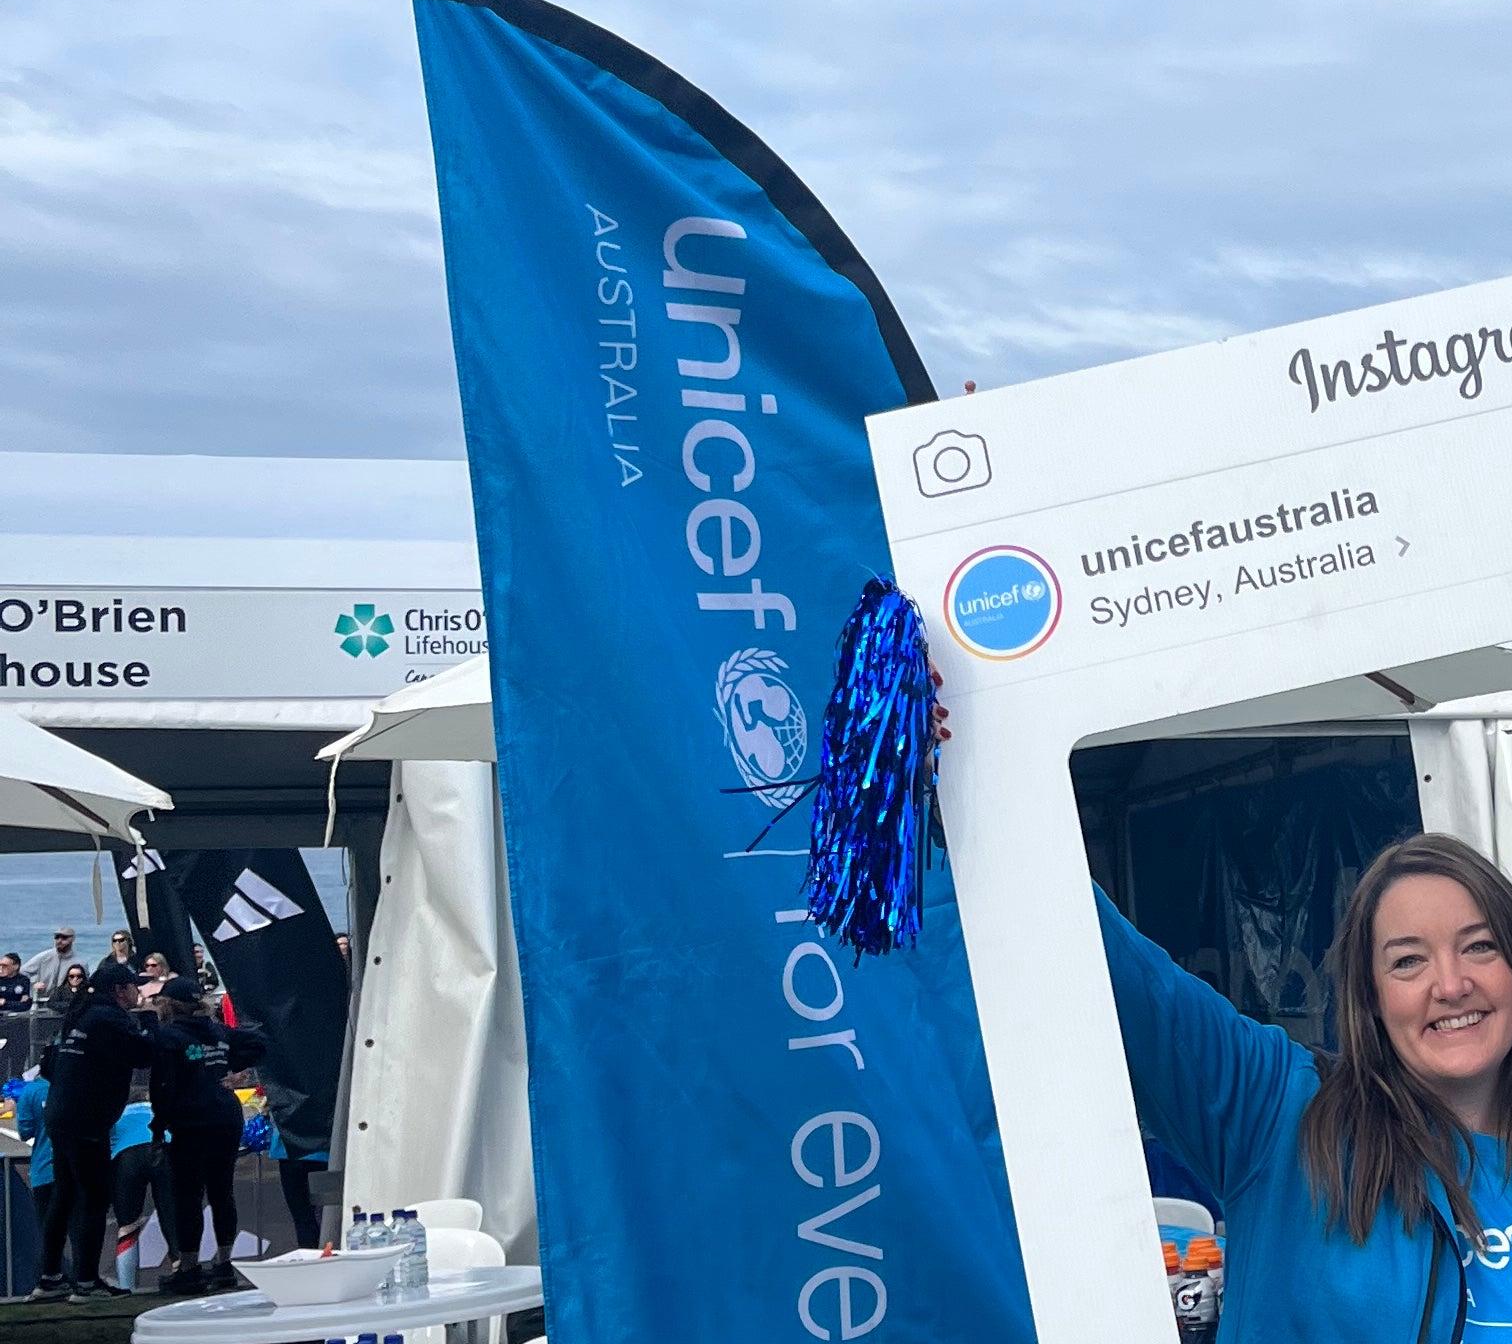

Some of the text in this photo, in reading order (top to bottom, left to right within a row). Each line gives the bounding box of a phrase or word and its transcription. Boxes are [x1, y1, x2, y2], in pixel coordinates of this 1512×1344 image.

[585, 202, 643, 488] AUSTRALIA
[661, 215, 797, 631] unicef
[1081, 487, 1380, 578] unicefaustralia
[0, 599, 186, 632] O'Brien
[960, 584, 1019, 616] unicef
[1090, 541, 1377, 626] Sydney, Australia
